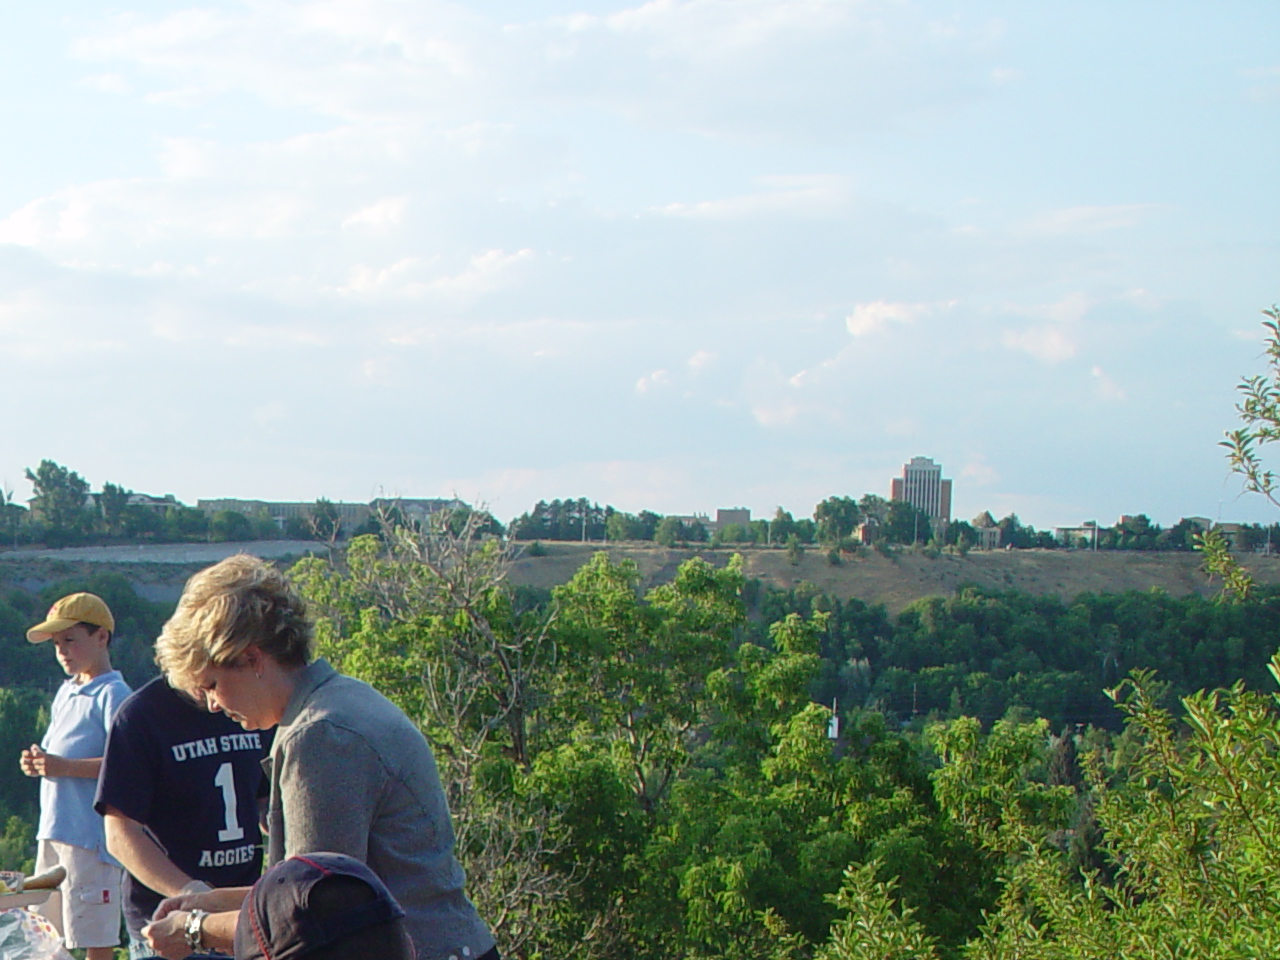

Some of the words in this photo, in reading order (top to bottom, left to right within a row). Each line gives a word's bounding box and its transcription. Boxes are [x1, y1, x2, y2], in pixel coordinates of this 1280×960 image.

[172, 737, 219, 762] UTAH
[220, 733, 262, 752] STATE
[214, 762, 244, 842] 1
[198, 844, 255, 867] AGGIES
